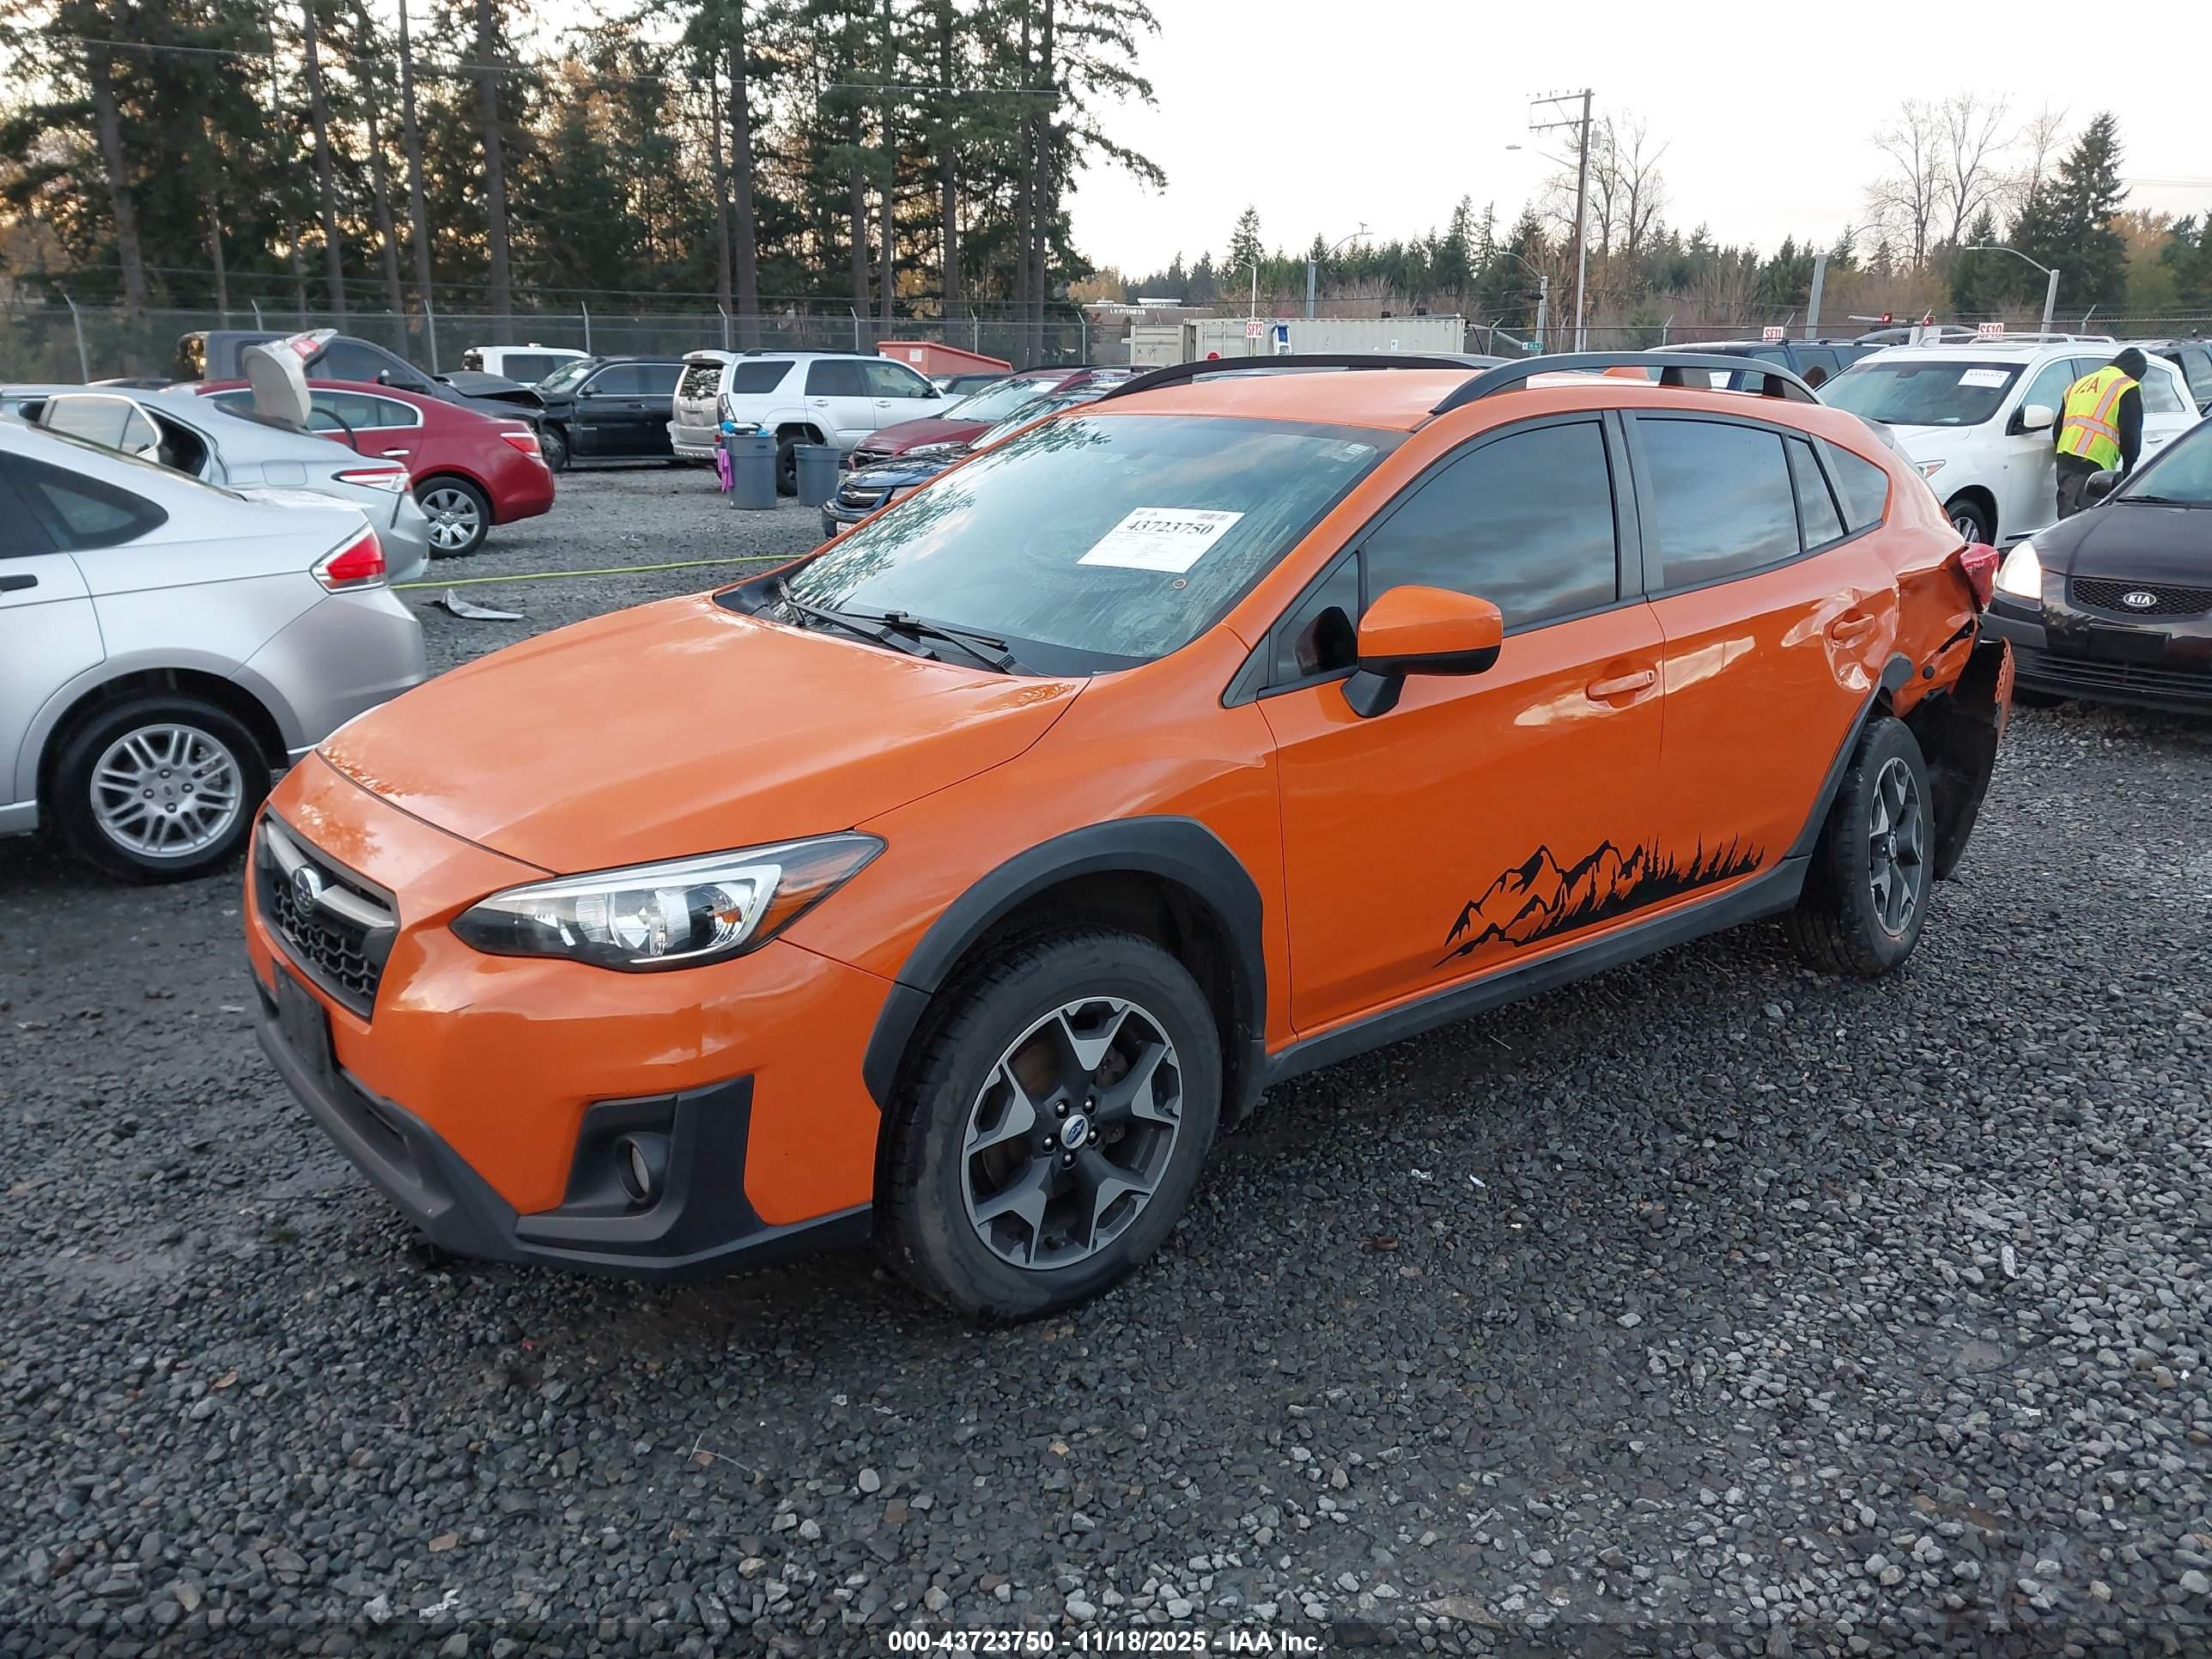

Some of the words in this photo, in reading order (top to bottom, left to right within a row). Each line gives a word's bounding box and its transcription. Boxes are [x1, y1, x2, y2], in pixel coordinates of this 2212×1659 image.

[1247, 323, 1263, 336] SF12
[1126, 520, 1215, 535] 43723750
[2128, 594, 2150, 605] KIA
